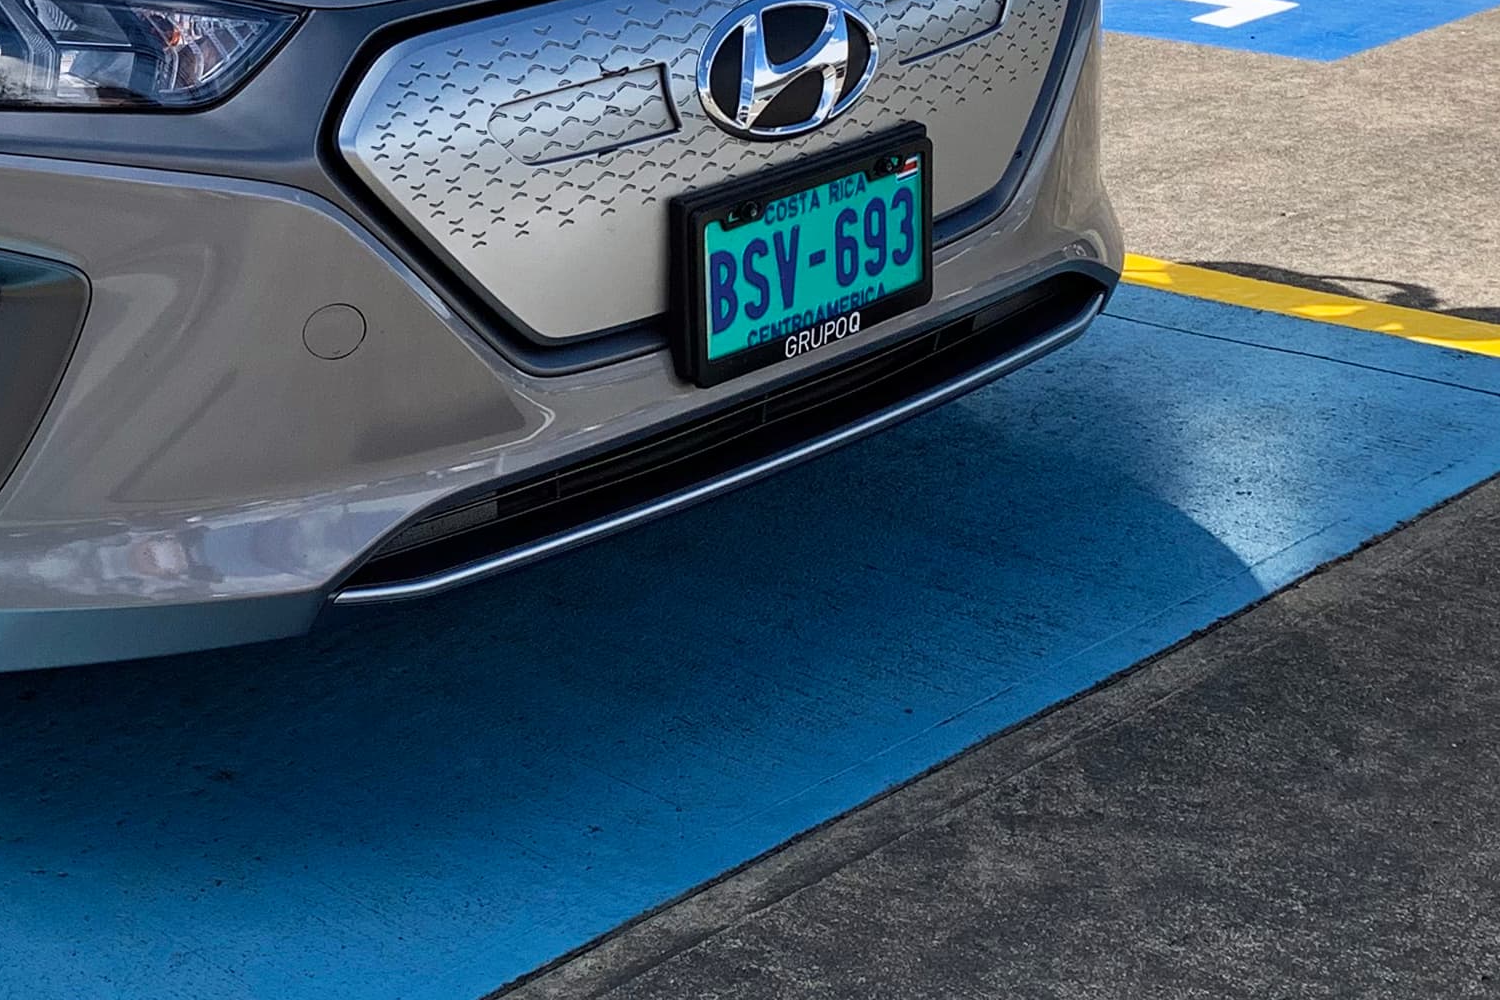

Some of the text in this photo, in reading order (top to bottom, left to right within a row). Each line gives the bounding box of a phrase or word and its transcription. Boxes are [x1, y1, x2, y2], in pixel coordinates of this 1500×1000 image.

[763, 173, 867, 226] COSTA RICA
[709, 187, 915, 335] BSV-693
[747, 282, 887, 347] CENTROAMERICA
